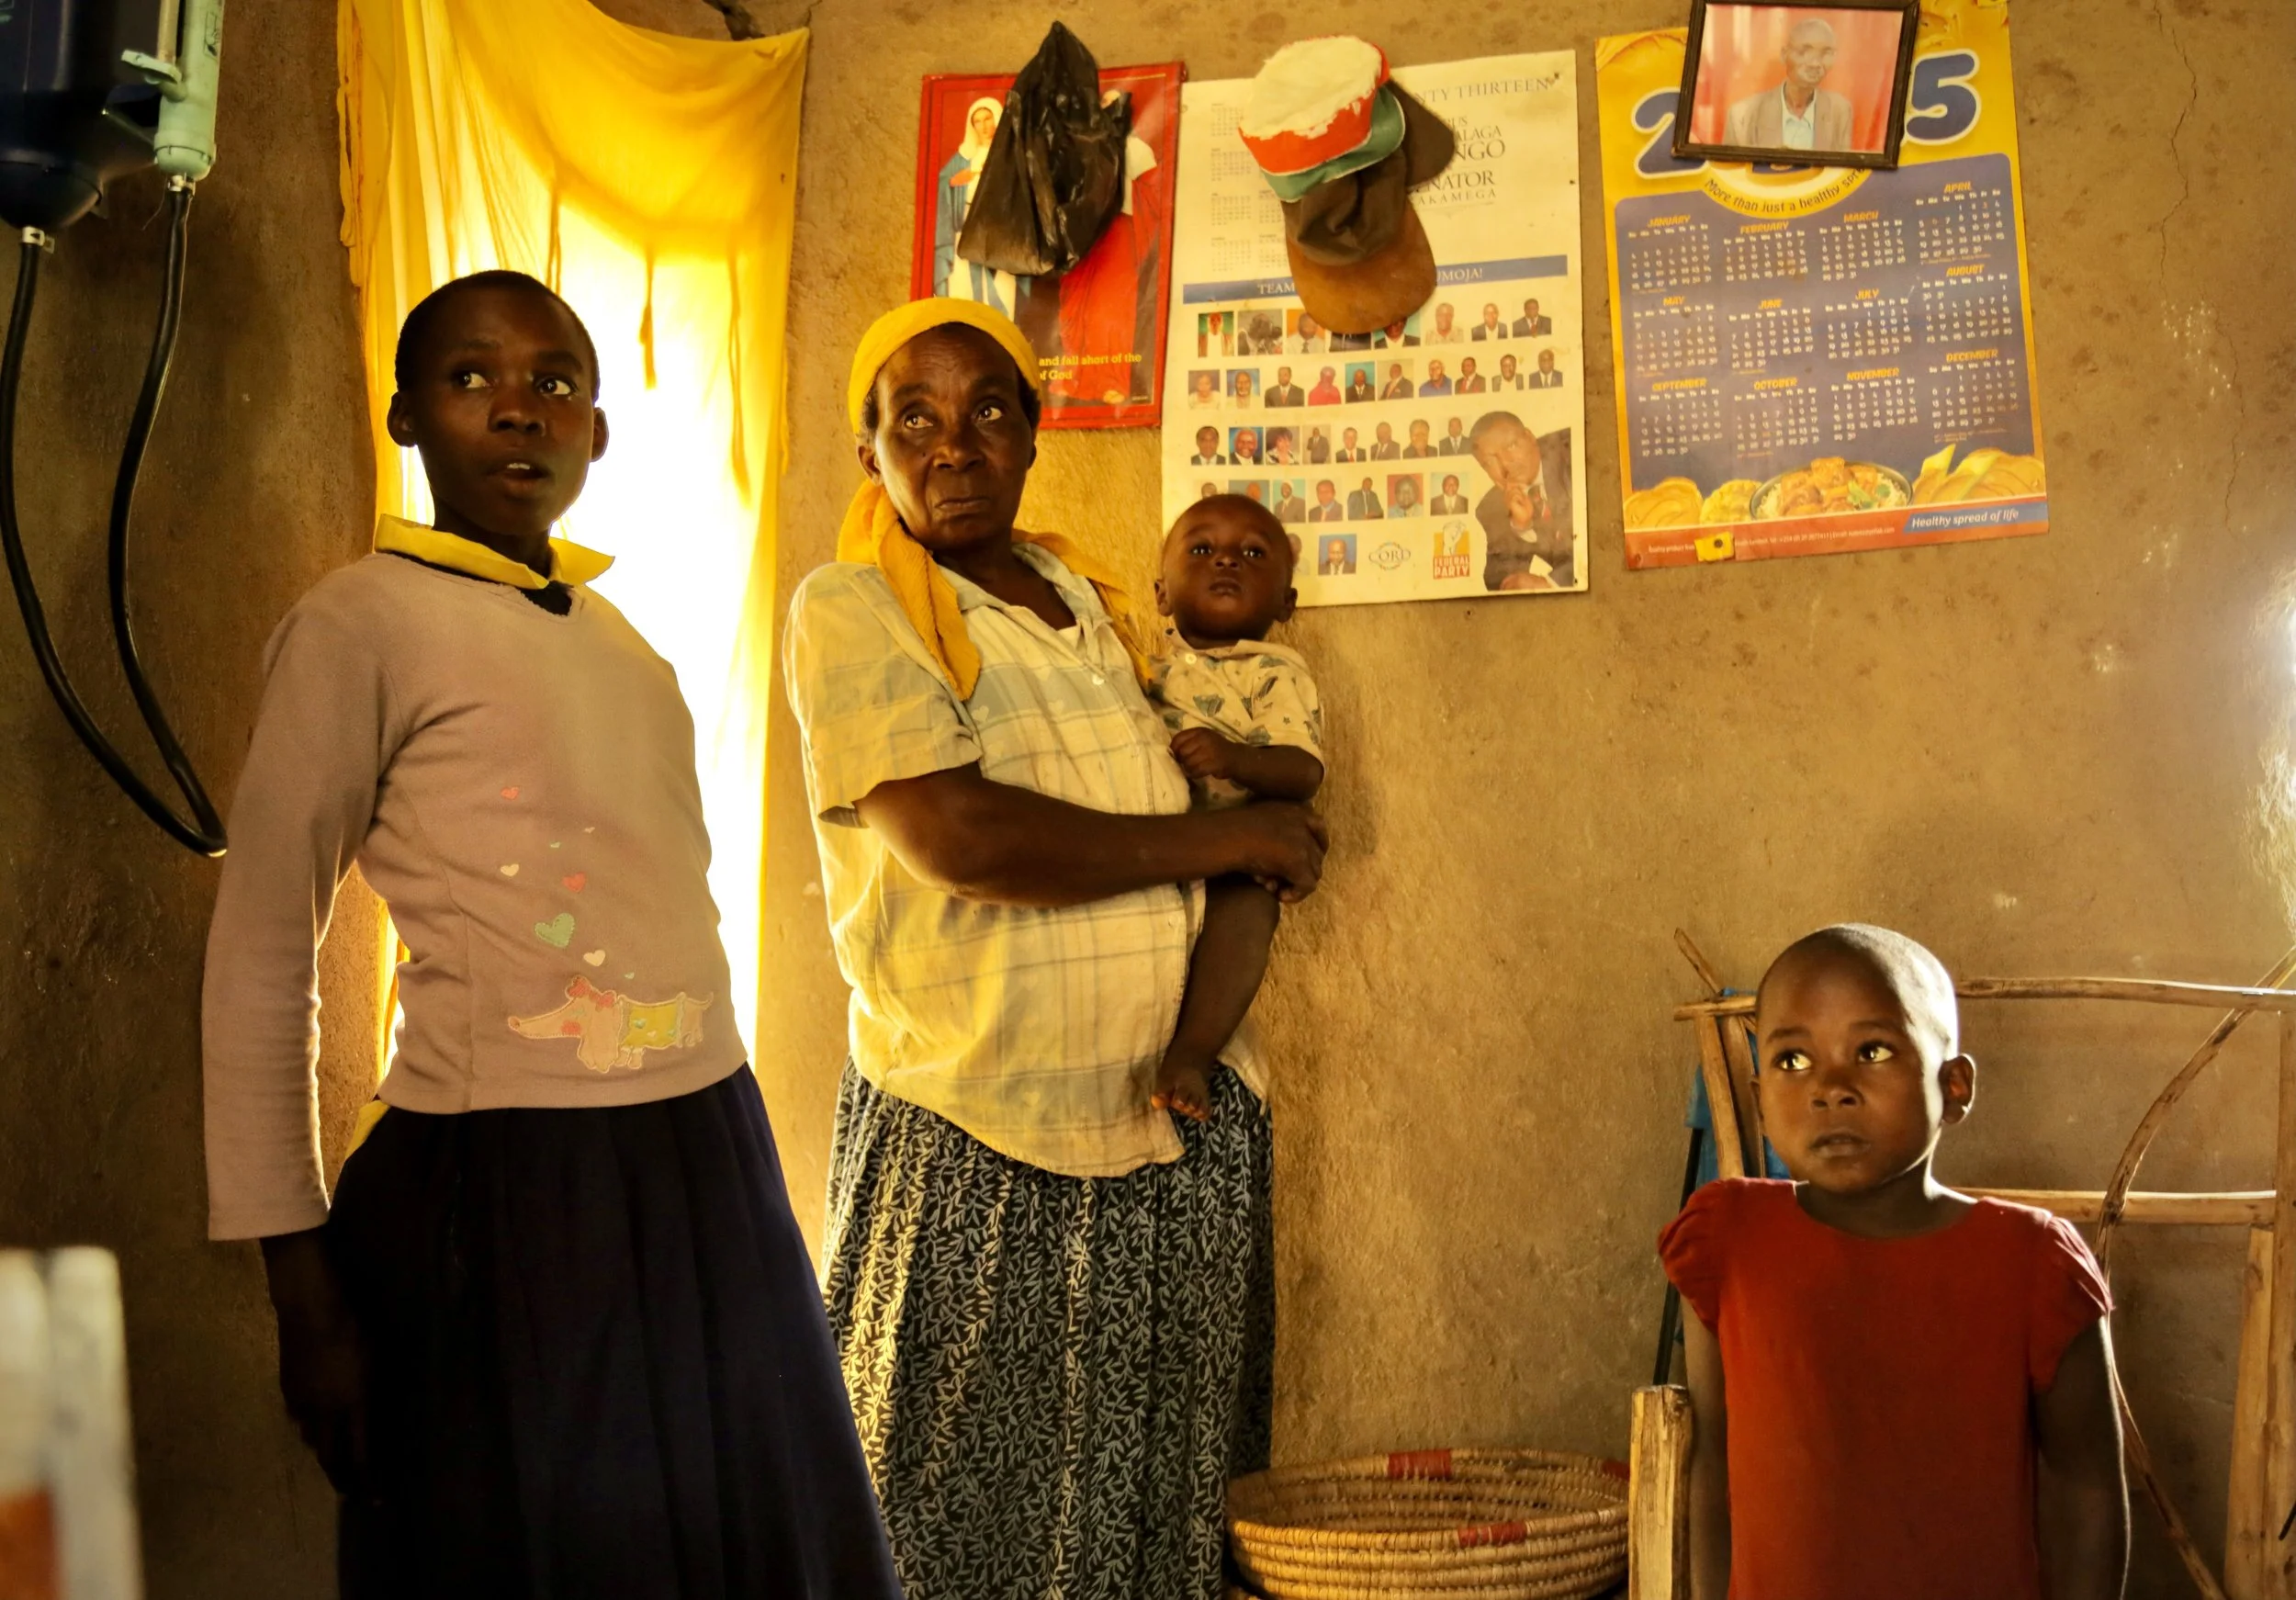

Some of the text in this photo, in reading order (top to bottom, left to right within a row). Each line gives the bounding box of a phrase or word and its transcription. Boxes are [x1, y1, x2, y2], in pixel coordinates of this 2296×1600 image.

[1455, 79, 1548, 99] THIRTEEN
[1458, 139, 1506, 161] NGO
[1424, 170, 1496, 192] NATOR
[1944, 182, 1971, 193] APRIL
[1418, 188, 1497, 205] AKAMEGA
[1705, 167, 1865, 213] More than just a healthy spre
[1843, 211, 1878, 222] MARCH
[1947, 265, 1984, 276] AUGUST
[1257, 283, 1296, 295] TEAM
[1855, 289, 1879, 299] JULY
[1663, 297, 1683, 305] MAY
[1039, 353, 1142, 366] and fall short of the
[1946, 349, 1998, 362] DECEMBER
[1049, 369, 1073, 379] God
[1847, 367, 1899, 380] NOVEMBER
[1652, 378, 1706, 390] SEPTEMBER
[1754, 377, 1797, 389] OCTOBER
[1912, 508, 2020, 529] Healthy spread of life
[1434, 565, 1469, 578] PARTY
